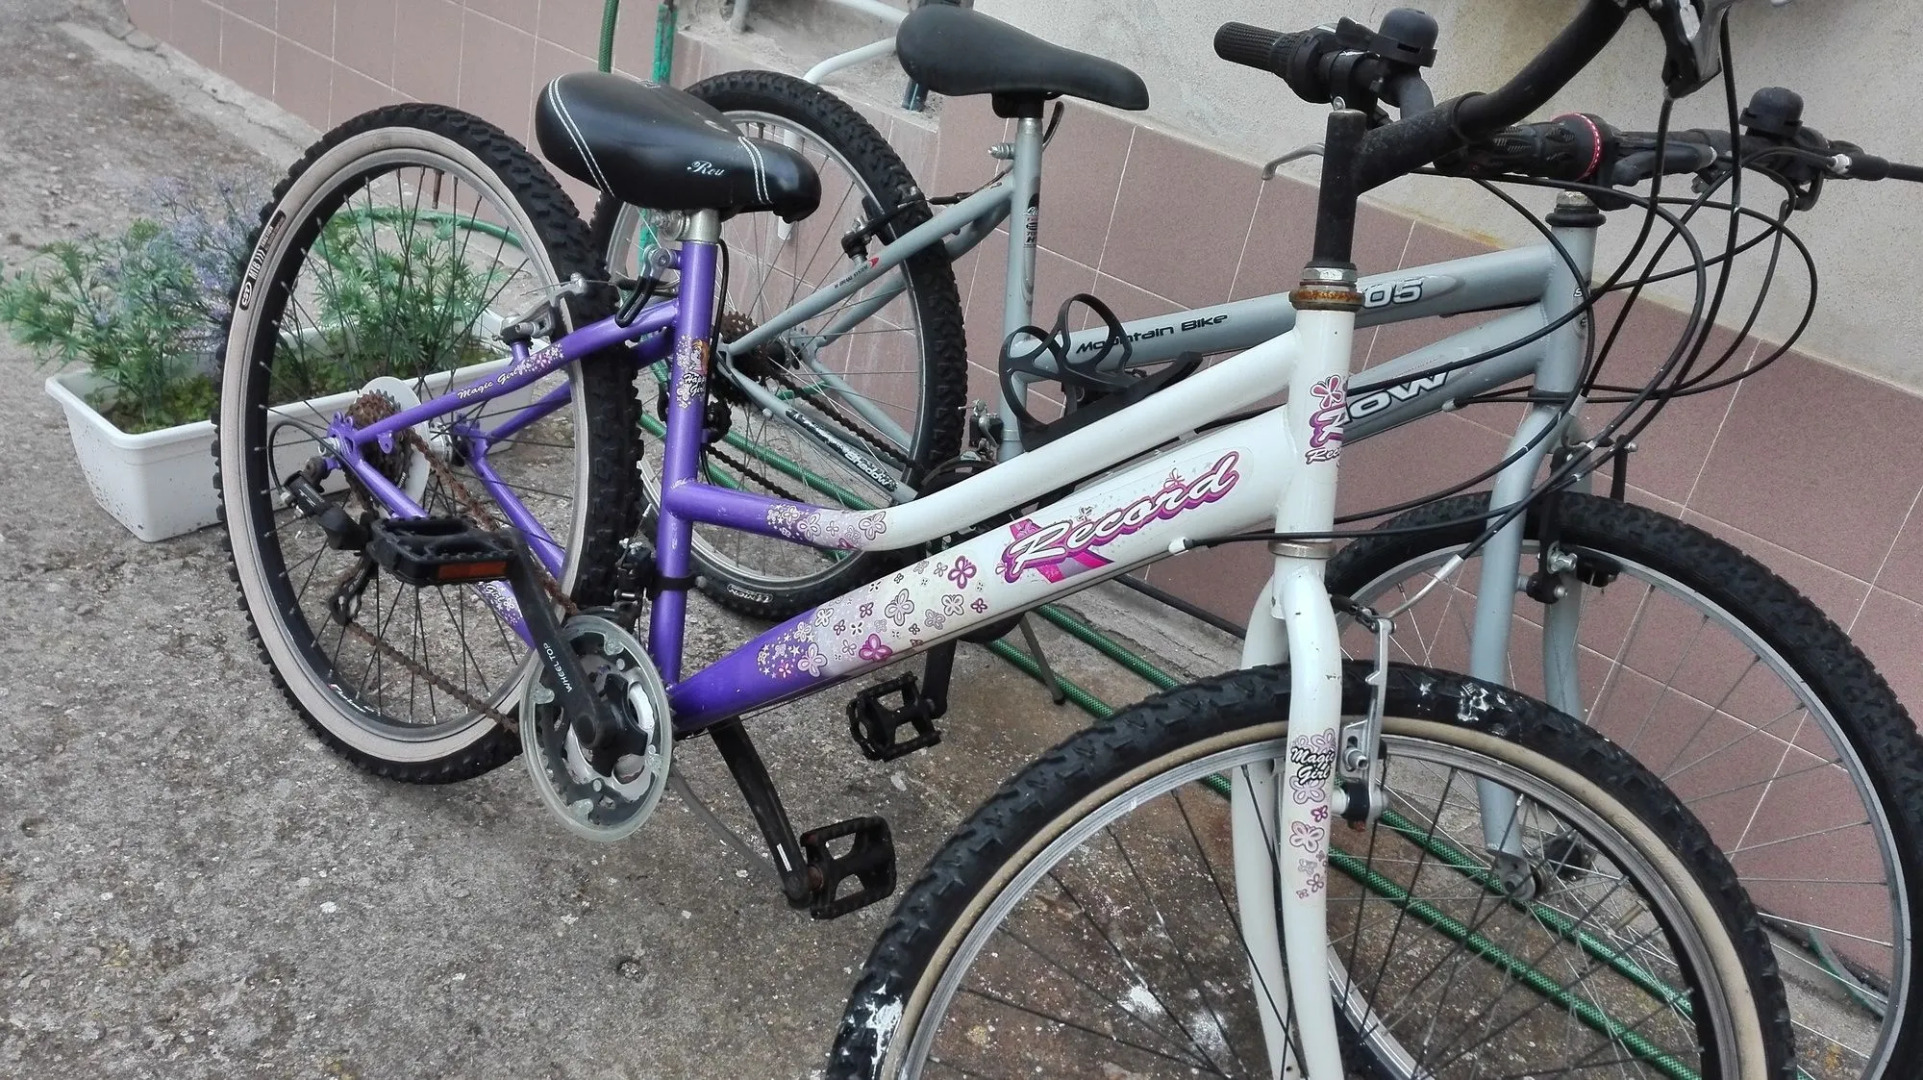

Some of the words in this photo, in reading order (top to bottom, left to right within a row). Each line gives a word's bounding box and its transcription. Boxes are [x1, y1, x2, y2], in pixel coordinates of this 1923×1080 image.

[249, 261, 261, 280] MTB
[1181, 314, 1228, 332] Bike
[457, 381, 494, 399] Magic
[1002, 451, 1240, 583] Record
[543, 642, 556, 661] TOP
[554, 661, 573, 693] WHEEL
[1291, 746, 1335, 769] Magic
[1297, 764, 1331, 785] Girl
